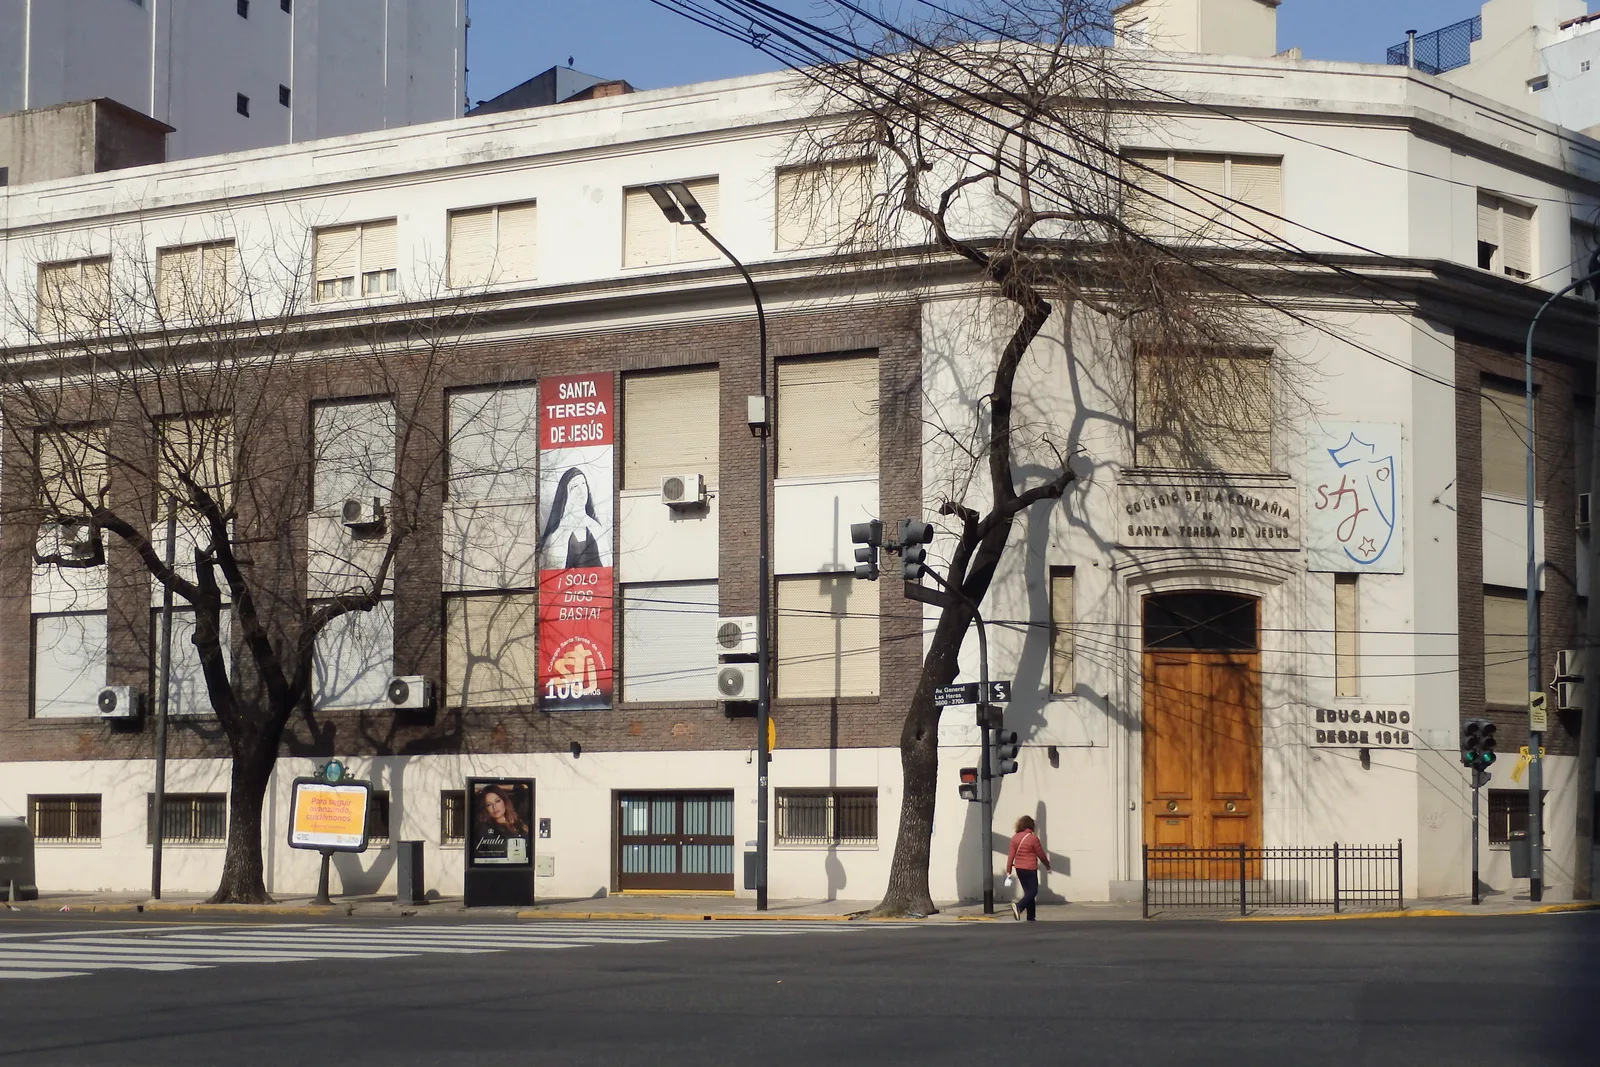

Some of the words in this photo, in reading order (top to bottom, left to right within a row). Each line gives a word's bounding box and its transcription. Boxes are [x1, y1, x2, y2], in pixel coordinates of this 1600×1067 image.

[559, 381, 597, 400] SANTA
[546, 401, 607, 419] TERESA
[550, 426, 566, 443] DE
[567, 420, 604, 442] JESÚS
[1126, 492, 1179, 516] COLEGIO
[1185, 490, 1201, 503] DE
[1207, 491, 1222, 503] LA
[1202, 511, 1213, 521] DE
[1127, 525, 1170, 537] SANTA
[1179, 525, 1221, 538] TERESA
[1230, 526, 1245, 538] DE
[564, 590, 594, 603] DIOS
[559, 606, 601, 621] BASTA!
[1316, 709, 1410, 724] EDUCANDO
[1316, 730, 1369, 744] DESDE
[311, 797, 327, 806] Para
[328, 799, 352, 807] seguir
